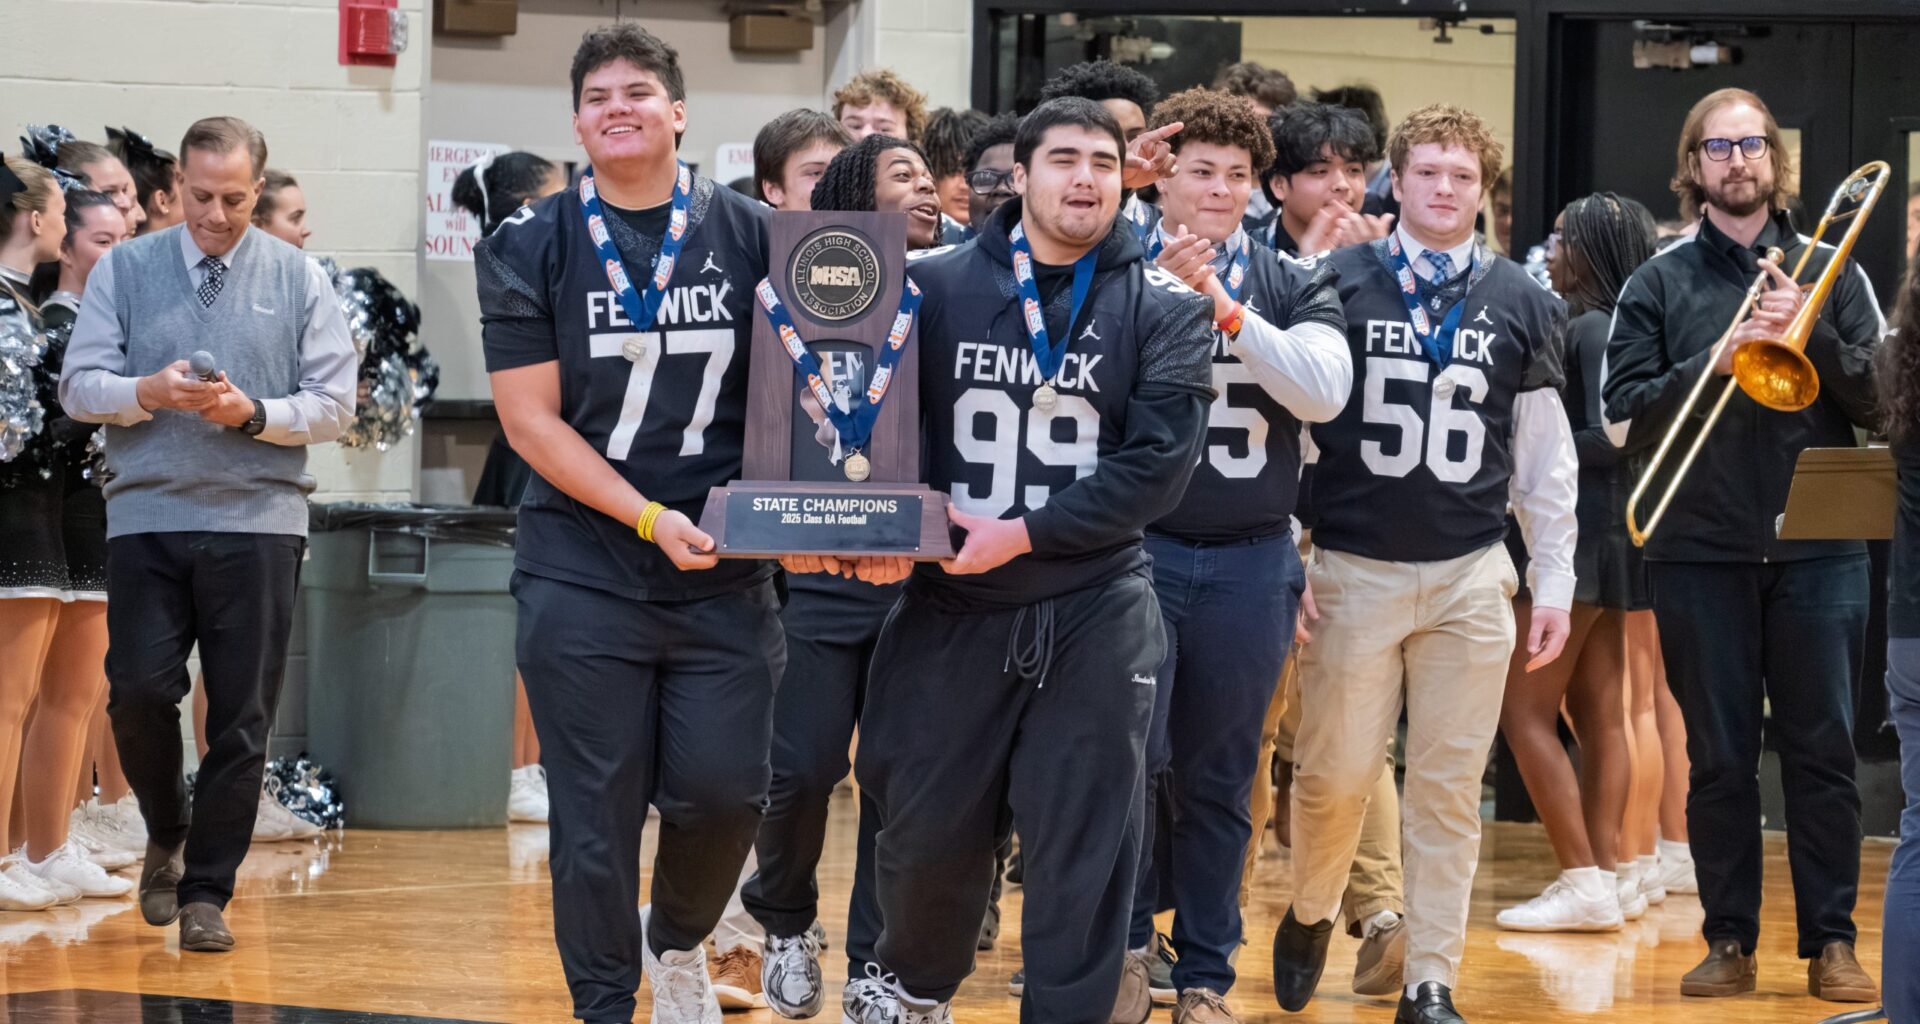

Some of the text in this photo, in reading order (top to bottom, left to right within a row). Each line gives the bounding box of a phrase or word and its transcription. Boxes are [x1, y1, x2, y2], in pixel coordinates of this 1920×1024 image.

[426, 234, 480, 255] SOUN
[446, 215, 466, 232] will
[797, 237, 875, 315] ILLINOIS HIGH SCHOOL ASSOCIATION
[586, 281, 733, 328] FEWICK
[954, 341, 1103, 393] FENWCK
[1366, 320, 1496, 366] FENICK
[589, 329, 735, 461] 77
[1360, 356, 1490, 483] 56
[1193, 363, 1269, 478] 5
[951, 388, 1100, 519] 99
[753, 497, 898, 513] STATE CHAMPIONS
[781, 513, 867, 525] 2025 Class 6A Football
